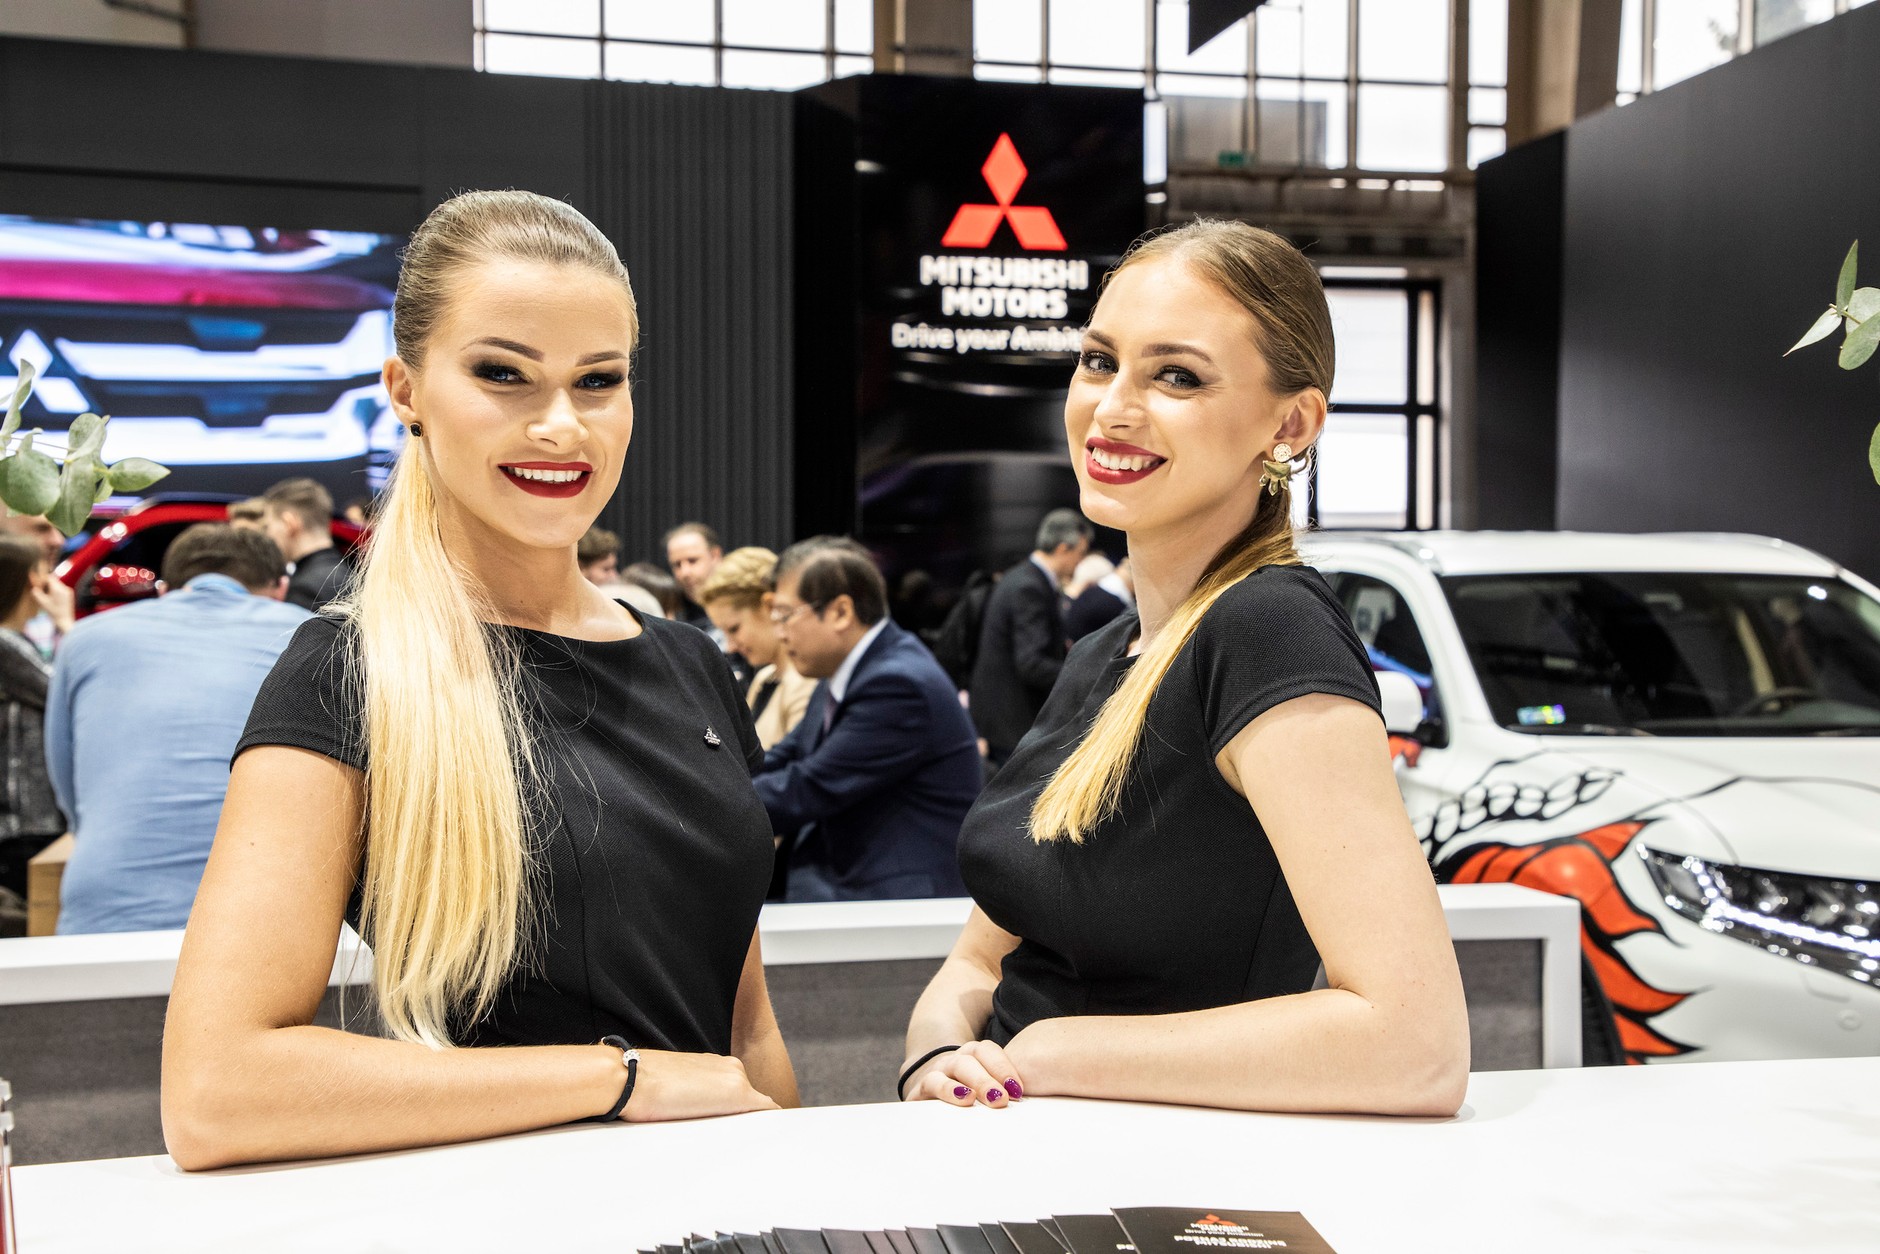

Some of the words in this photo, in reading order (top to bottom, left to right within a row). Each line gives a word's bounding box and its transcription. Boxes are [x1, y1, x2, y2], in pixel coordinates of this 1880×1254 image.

[919, 254, 1089, 290] MITSUBISHI
[941, 286, 1069, 319] MOTORS
[891, 322, 955, 349] Drive
[955, 328, 1011, 354] your
